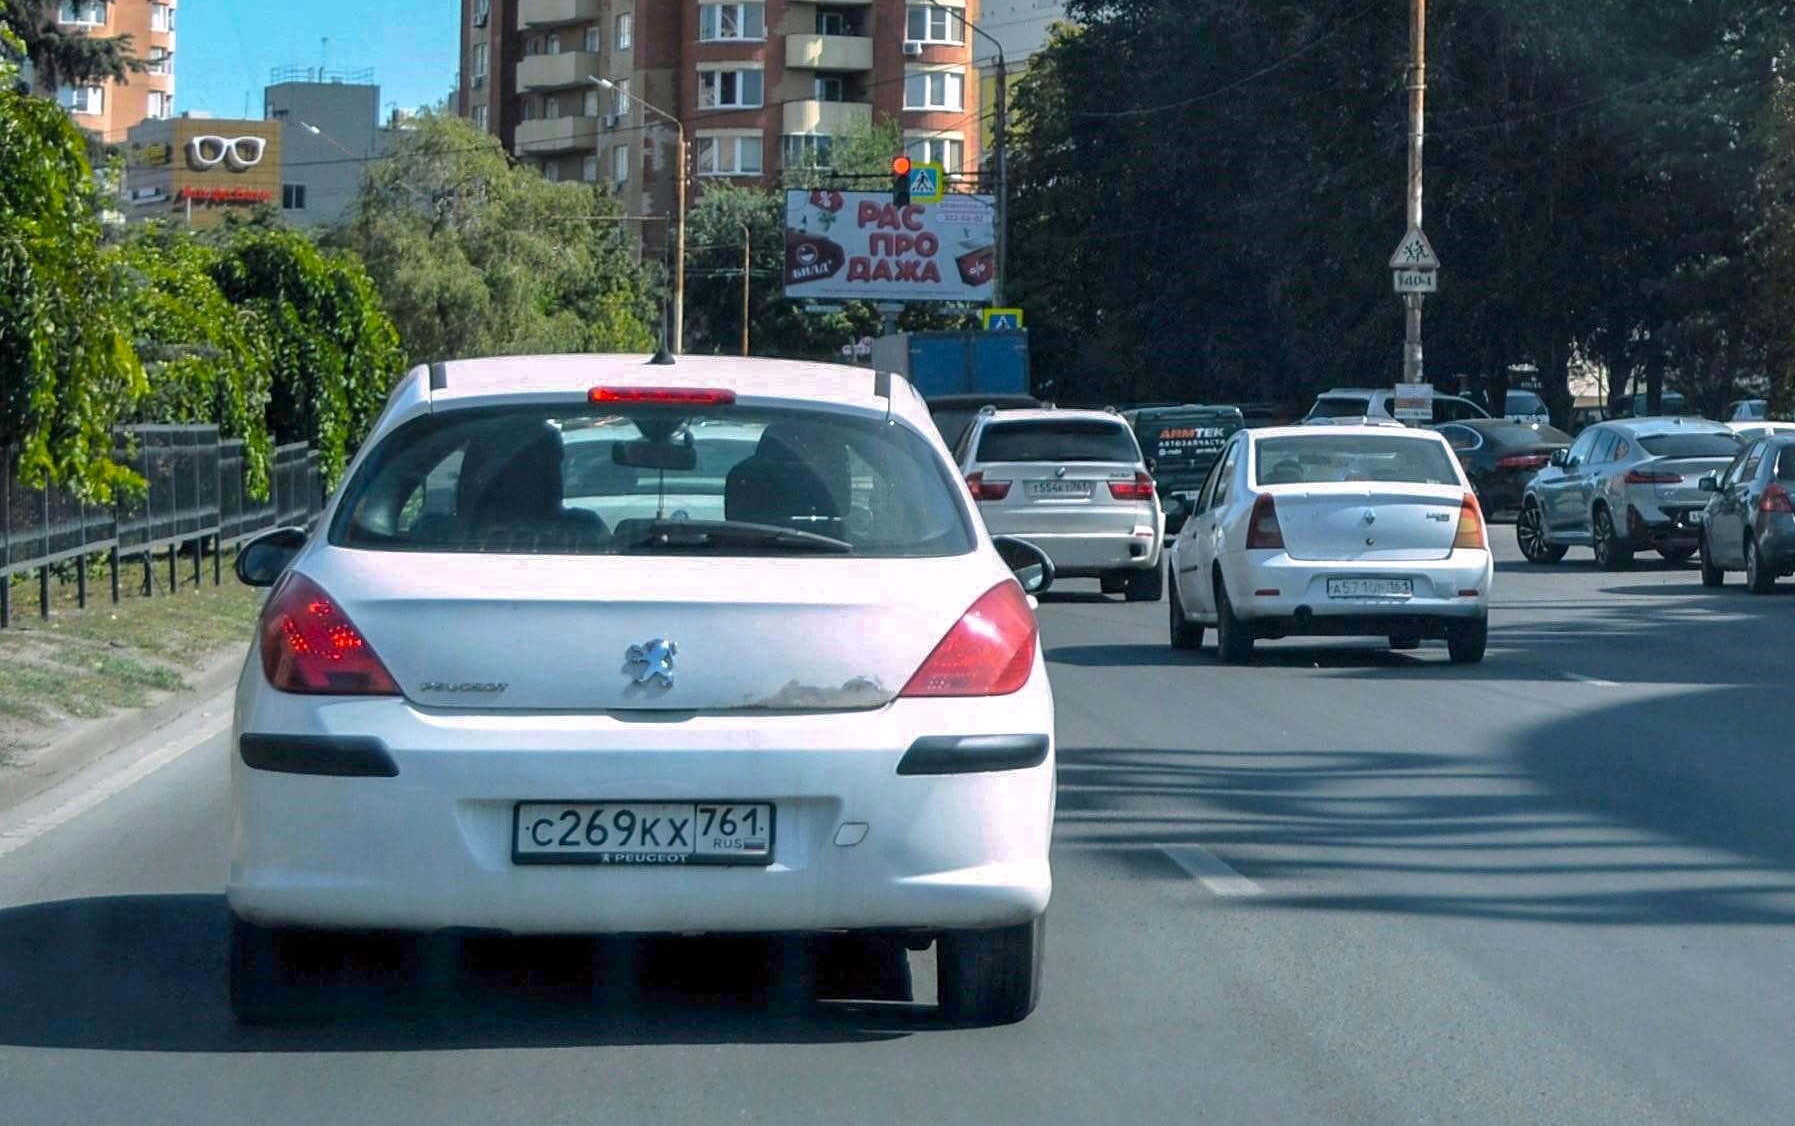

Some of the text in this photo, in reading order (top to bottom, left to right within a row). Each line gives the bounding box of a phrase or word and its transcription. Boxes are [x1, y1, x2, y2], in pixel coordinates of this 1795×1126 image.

[857, 200, 926, 231] РАС
[869, 232, 940, 258] ПРО
[846, 256, 942, 283] ДАЖА
[531, 807, 758, 846] С269КХ 761
[713, 838, 743, 849] RUS
[614, 852, 689, 863] PEUGEOT
